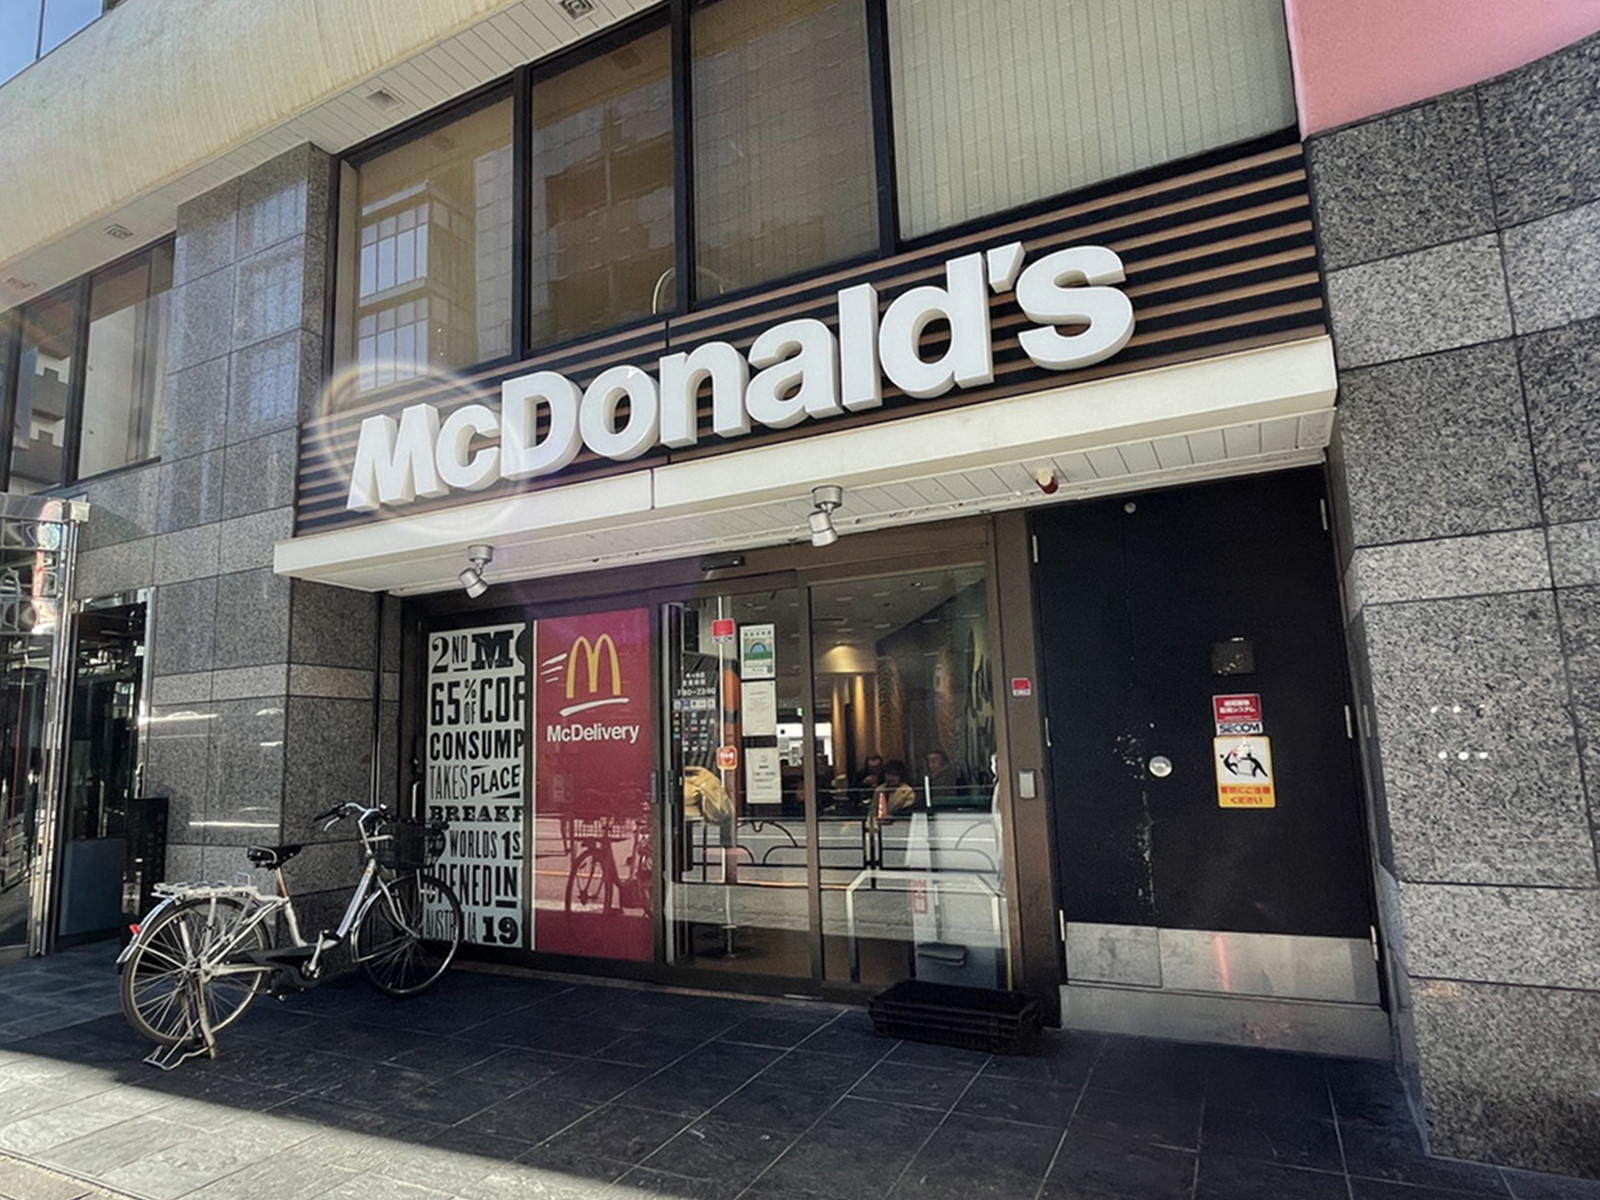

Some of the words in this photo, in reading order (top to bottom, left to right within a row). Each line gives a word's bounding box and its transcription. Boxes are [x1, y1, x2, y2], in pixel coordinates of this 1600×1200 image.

[346, 241, 1136, 512] McDonald's
[547, 723, 640, 744] McDelivery
[1219, 723, 1261, 733] SECOM
[430, 728, 524, 761] CONSUMP
[430, 765, 468, 800] TAKES
[471, 764, 521, 797] PLACE
[449, 830, 498, 859] WORLDS
[496, 866, 518, 898] IN
[482, 915, 519, 945] 19
